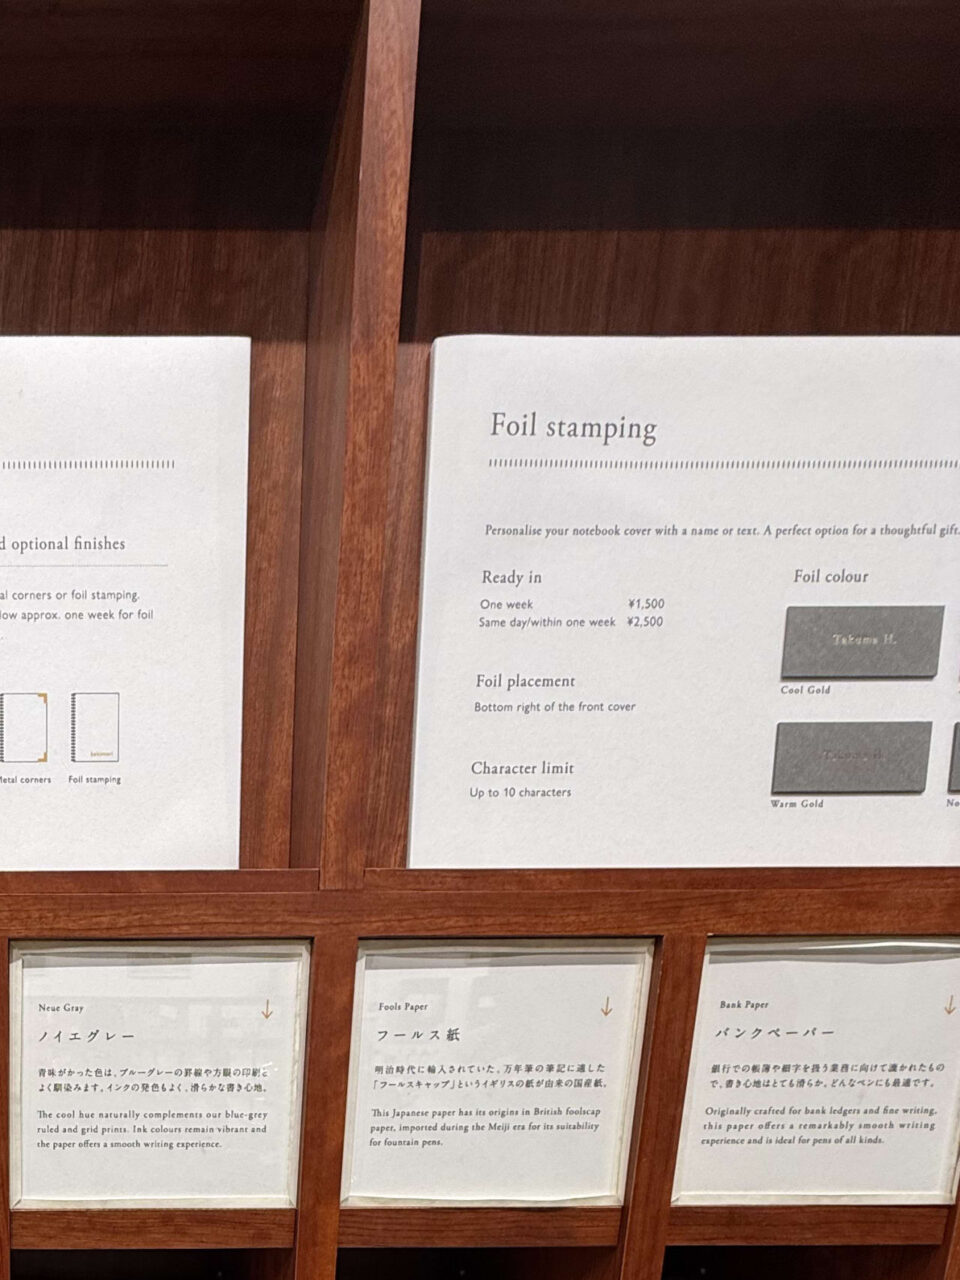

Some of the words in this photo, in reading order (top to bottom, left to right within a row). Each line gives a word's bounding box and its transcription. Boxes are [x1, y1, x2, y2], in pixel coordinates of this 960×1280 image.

[490, 411, 536, 436] Foil
[546, 415, 657, 447] stamping
[484, 523, 542, 536] Personalise
[544, 527, 569, 539] your
[572, 523, 621, 536] notebook
[623, 527, 652, 536] cover
[654, 523, 678, 536] with
[681, 527, 687, 536] a
[690, 527, 719, 536] name
[721, 527, 734, 536] or
[736, 527, 760, 536] text.
[762, 524, 772, 536] A
[774, 523, 812, 539] perfect
[814, 524, 849, 539] option
[852, 523, 868, 536] for
[870, 527, 877, 535] a
[879, 522, 937, 539] thoughtful
[11, 535, 68, 555] optional
[74, 534, 125, 550] finishes
[481, 568, 524, 588] Ready
[528, 570, 542, 584] in
[793, 568, 820, 583] Foil
[824, 567, 869, 583] colour
[479, 598, 503, 610] One
[505, 598, 533, 610] week
[628, 598, 665, 610] ¥1,500
[478, 616, 506, 628] Same
[509, 616, 562, 630] day/within
[565, 618, 585, 627] one
[588, 616, 616, 627] week
[626, 615, 664, 628] ¥2,500
[475, 672, 502, 688] Foil
[506, 673, 576, 692] placement
[780, 682, 804, 695] Cool
[806, 684, 831, 695] Gold
[474, 701, 513, 712] Bottom
[516, 701, 541, 715] right
[543, 700, 556, 712] of
[557, 701, 575, 712] the
[578, 700, 604, 712] front
[607, 703, 636, 712] cover
[470, 760, 537, 775] Character
[541, 760, 574, 774] limit
[68, 774, 83, 784] Foil
[85, 776, 121, 786] stamping
[469, 786, 485, 800] Up
[487, 788, 500, 798] to
[503, 786, 516, 798] 10
[518, 786, 572, 798] characters
[770, 799, 797, 808] Warm
[800, 799, 824, 808] Gold
[38, 1003, 60, 1012] Neue
[62, 1002, 84, 1014] Gray
[378, 1002, 401, 1011] Fools
[404, 1002, 428, 1013] Paper
[719, 1000, 742, 1009] Bank
[744, 1000, 769, 1011] Paper
[38, 1029, 134, 1043] ノイエグレー
[377, 1027, 460, 1042] フールス紙
[714, 1026, 834, 1040] バンクペーパー
[369, 1137, 382, 1147] for
[383, 1137, 419, 1147] fountain
[421, 1139, 443, 1149] pens.
